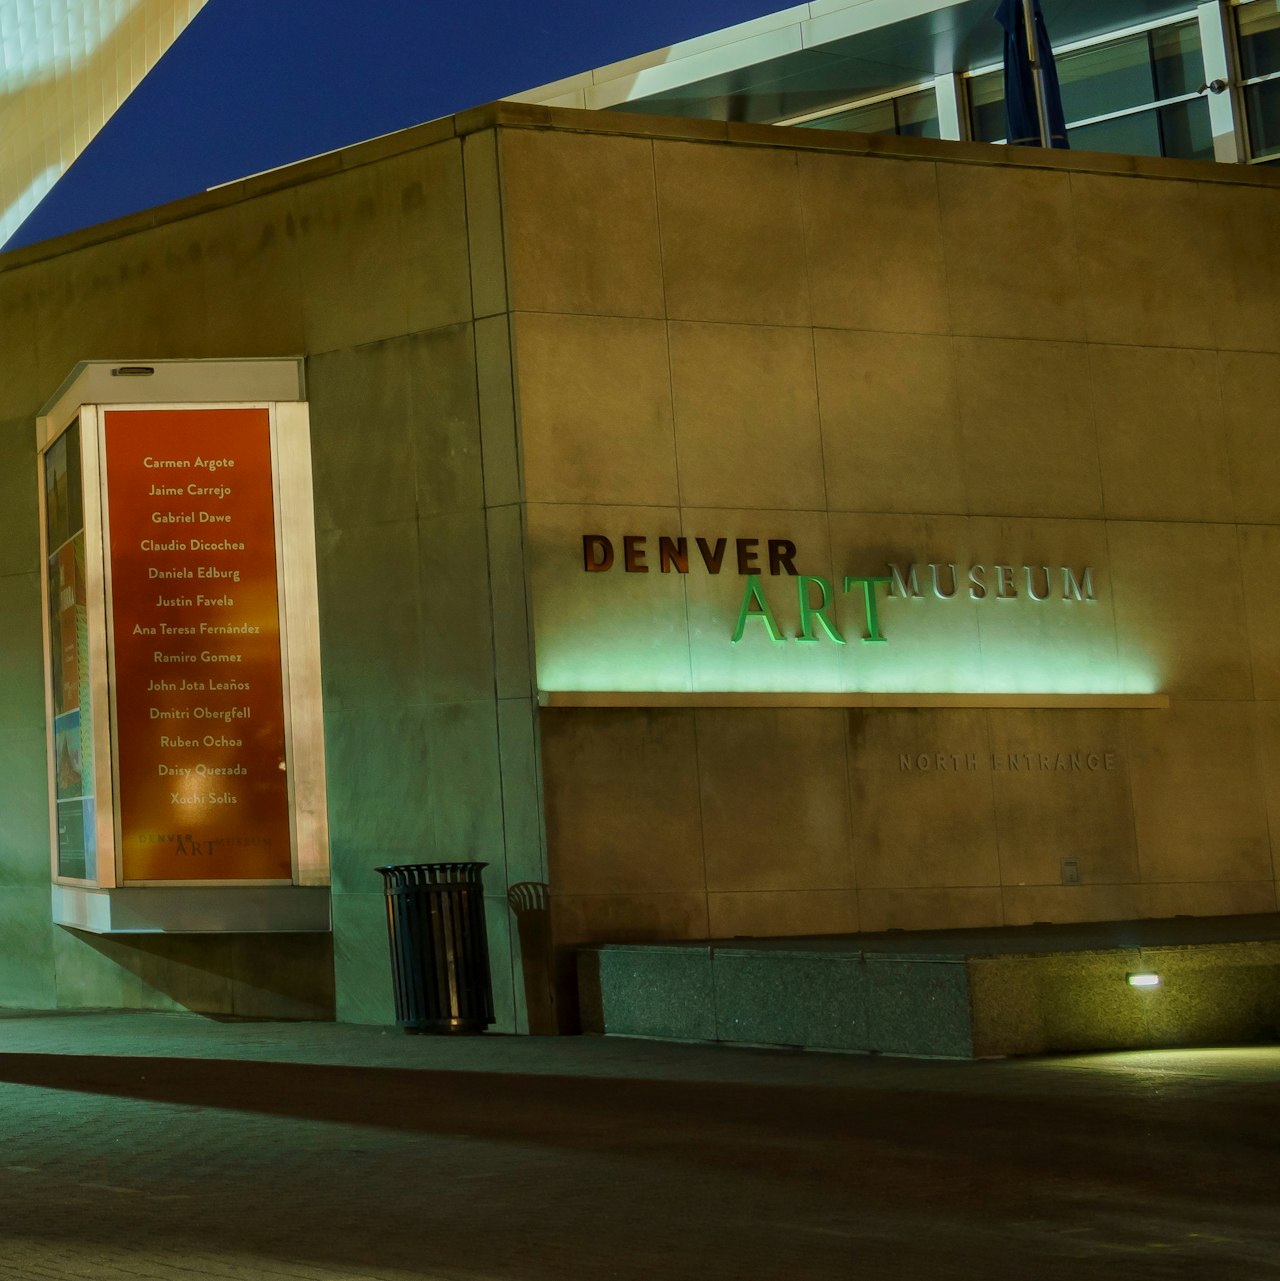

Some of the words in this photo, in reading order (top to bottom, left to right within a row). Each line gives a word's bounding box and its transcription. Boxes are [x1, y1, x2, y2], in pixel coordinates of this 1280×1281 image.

[143, 456, 191, 468] Carmen
[193, 456, 235, 472] Argote
[148, 484, 184, 496] Jaime
[186, 484, 232, 499] Carrejo
[151, 511, 195, 523] Gabriel
[199, 511, 232, 523] Dawe
[140, 539, 187, 551] Claudio
[190, 539, 245, 551] Dicochea
[582, 534, 799, 577] DENVER
[148, 567, 194, 579] Daniela
[197, 567, 241, 582] Edburg
[887, 562, 1097, 602] MUSEUM
[156, 595, 193, 607] Justin
[196, 594, 234, 606] Favela
[730, 575, 894, 645] ART
[132, 623, 157, 635] Ana
[159, 623, 196, 635] Teresa
[200, 622, 260, 634] Fernández
[154, 651, 197, 663] Ramiro
[200, 651, 242, 662] Gomez
[147, 680, 176, 691] John
[179, 679, 205, 691] Jota
[209, 679, 250, 690] Leaños
[149, 707, 190, 719] Dmitri
[193, 706, 251, 723] Obergfell
[160, 736, 200, 747] Ruben
[203, 735, 243, 747] Ochoa
[898, 753, 978, 771] NORTH
[991, 753, 1118, 771] ENTRANCE
[158, 764, 192, 780] Daisy
[195, 763, 248, 777] Quezada
[170, 792, 205, 805] Xochi
[208, 792, 238, 804] Solis
[138, 833, 193, 844] DENVER
[175, 839, 217, 857] ART
